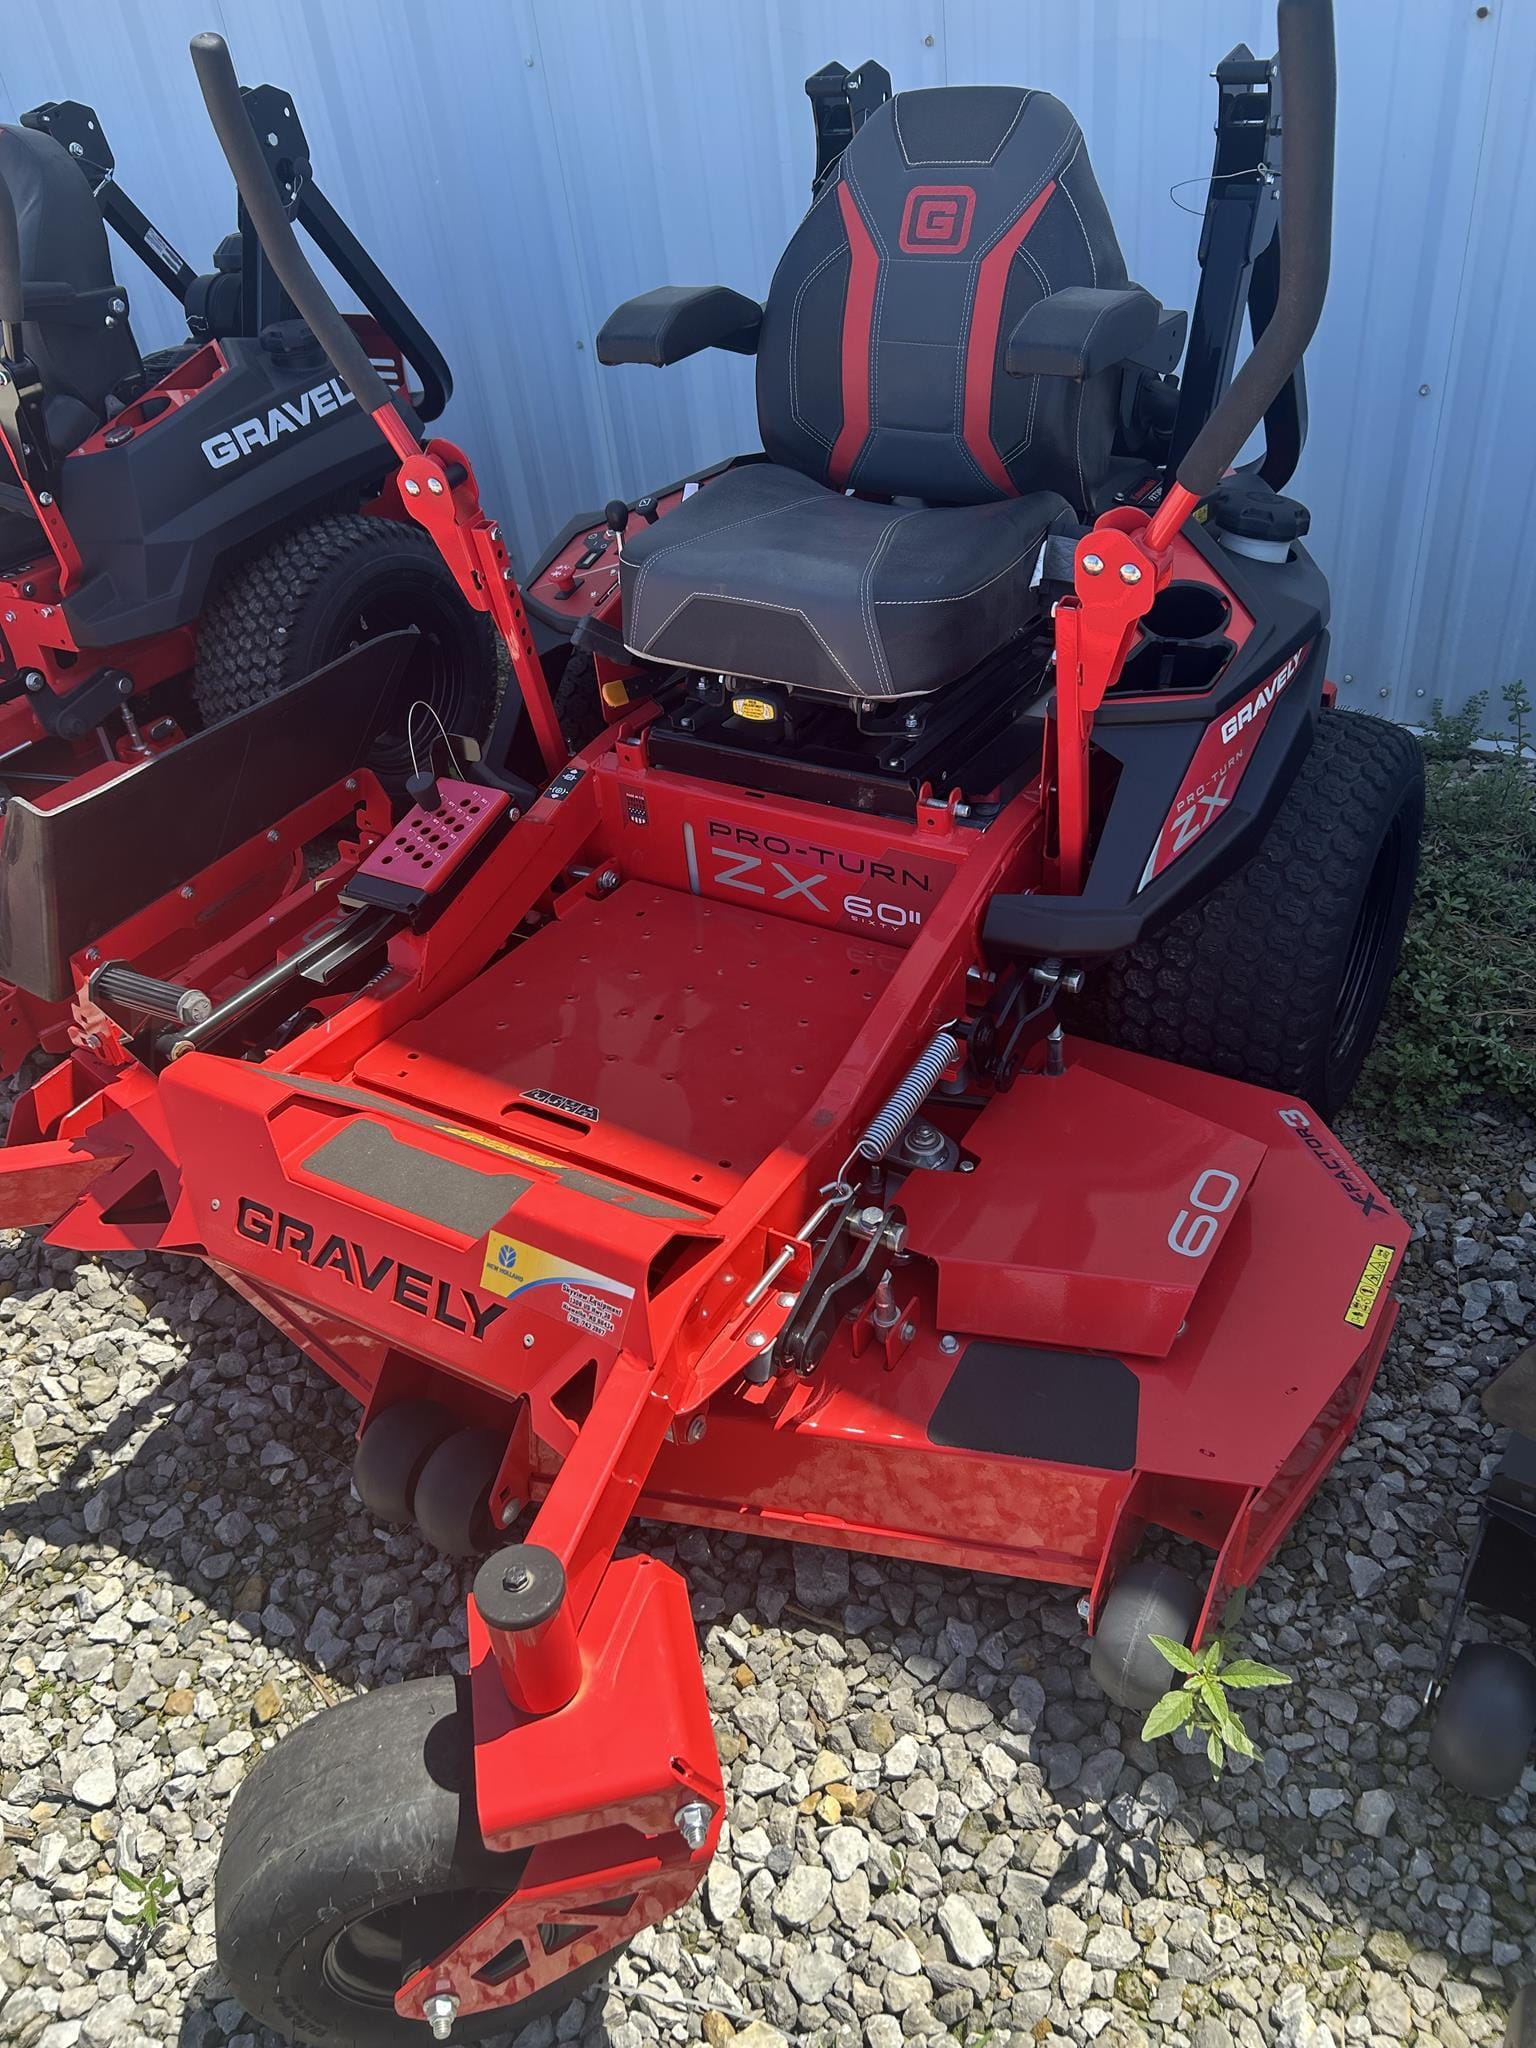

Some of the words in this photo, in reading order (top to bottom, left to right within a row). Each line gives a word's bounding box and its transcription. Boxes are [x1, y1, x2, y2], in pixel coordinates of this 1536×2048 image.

[201, 375, 356, 470] GRAVEL
[1221, 647, 1304, 745] GRAVELY
[1170, 775, 1231, 853] ZX
[1176, 749, 1244, 812] PRO-TURN
[711, 846, 830, 913] ZX
[851, 915, 899, 932] SIXTY
[1166, 1168, 1240, 1258] 60
[236, 1196, 508, 1342] GRAVELY
[562, 1283, 588, 1300] Skyview
[589, 1295, 622, 1316] Equipment
